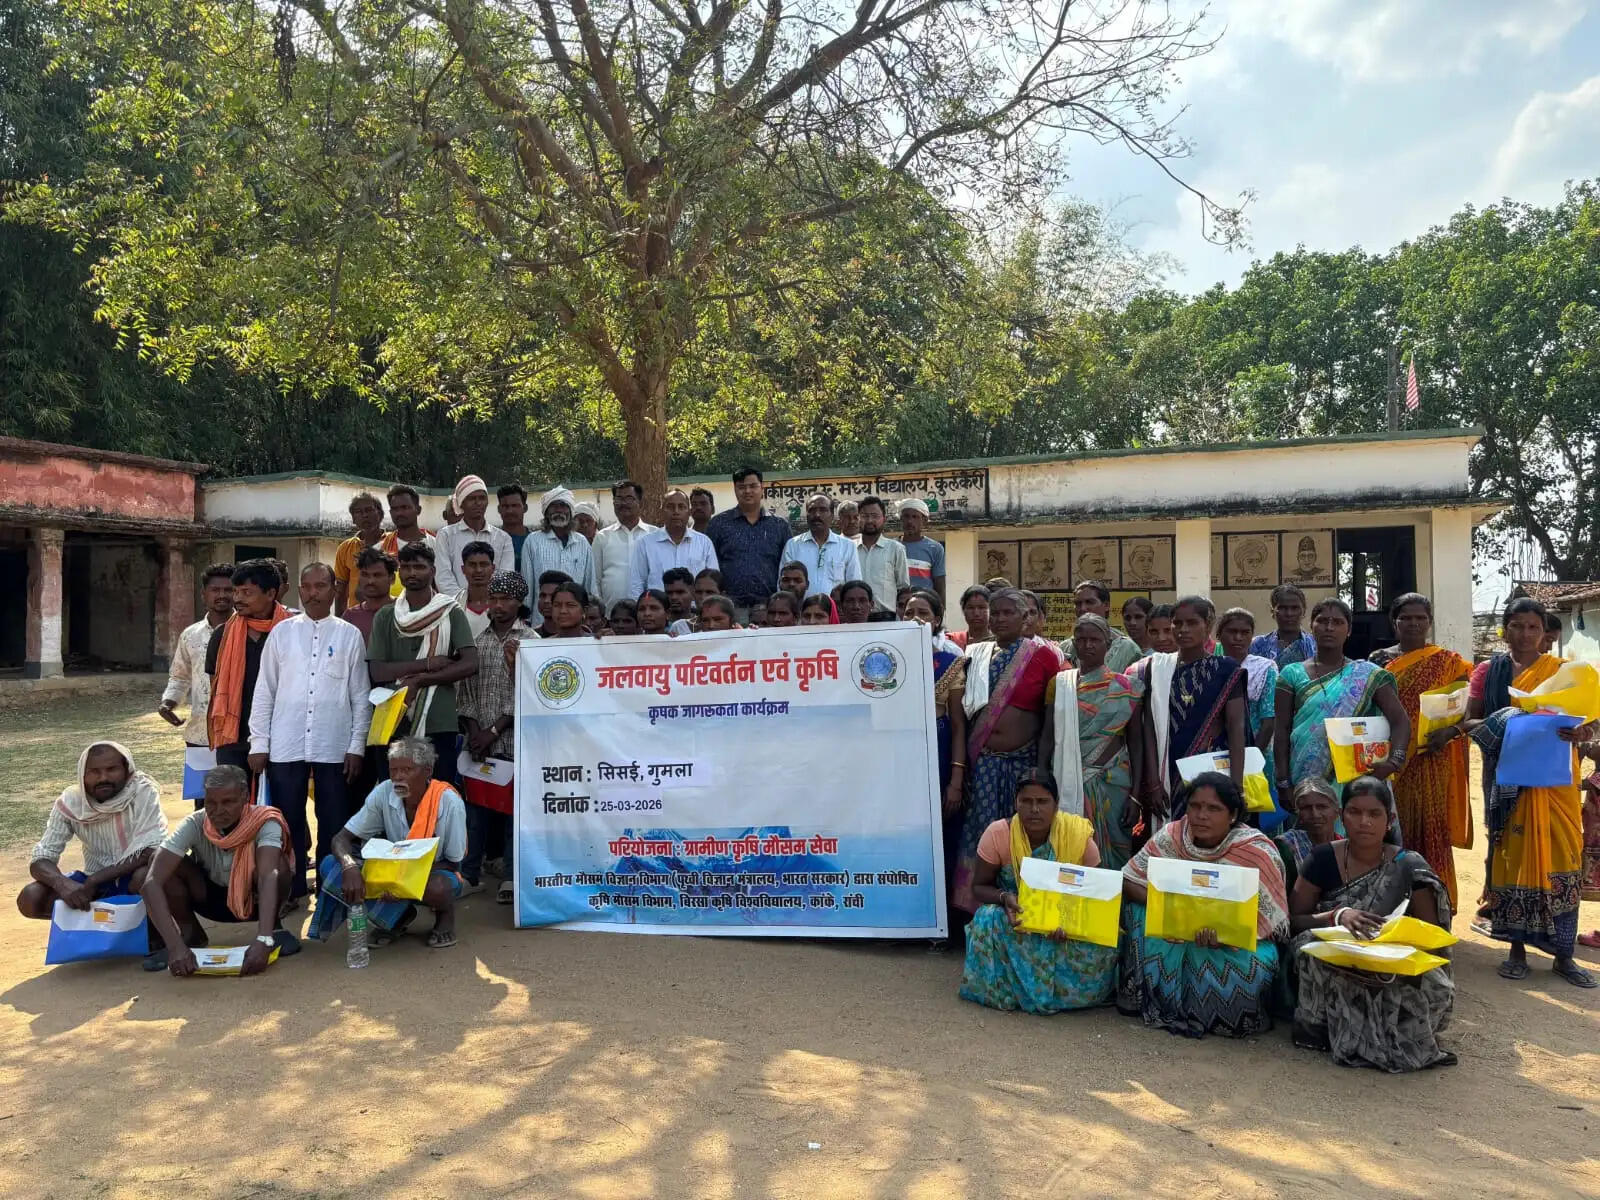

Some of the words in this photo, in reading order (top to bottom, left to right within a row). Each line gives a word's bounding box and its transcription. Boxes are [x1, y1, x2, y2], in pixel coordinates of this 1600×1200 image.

[837, 481, 872, 495] मध्य
[595, 664, 672, 695] जलवायु
[674, 653, 756, 686] परिवर्तन
[760, 652, 791, 682] एवं
[794, 649, 839, 692] कृषि
[648, 704, 679, 725] कृषक
[680, 702, 739, 718] जागरूकता
[740, 698, 789, 716] कार्यक्रम
[542, 765, 583, 783] स्थान
[597, 761, 644, 783] सिसई,
[648, 763, 693, 786] गुमला
[542, 792, 590, 814] दिनांक
[600, 800, 662, 812] 25-03-2026
[608, 837, 673, 857] परियोजना
[683, 837, 729, 857] ग्रामीण
[731, 836, 759, 862] कृषि
[762, 835, 806, 856] मौसम
[808, 834, 838, 854] सेवा
[535, 873, 572, 887] भारतीय
[575, 872, 603, 885] मौसम
[606, 872, 635, 886] विज्ञान
[639, 872, 669, 886] विभाग
[671, 870, 699, 889] (पृथ्वी
[702, 871, 735, 886] विज्ञान
[737, 871, 779, 887] मंत्रालय,
[783, 873, 808, 885] भारत
[811, 870, 850, 887] सरकार)
[877, 871, 918, 885] संपोषित
[589, 893, 610, 910] कृषि
[613, 893, 639, 907] मौसम
[643, 894, 676, 909] विभाग,
[680, 893, 708, 908] बिरसा
[711, 893, 736, 911] कृषि
[736, 894, 806, 909] विश्वविद्यालय,
[809, 893, 839, 909] कांके,
[843, 893, 864, 908] रांची
